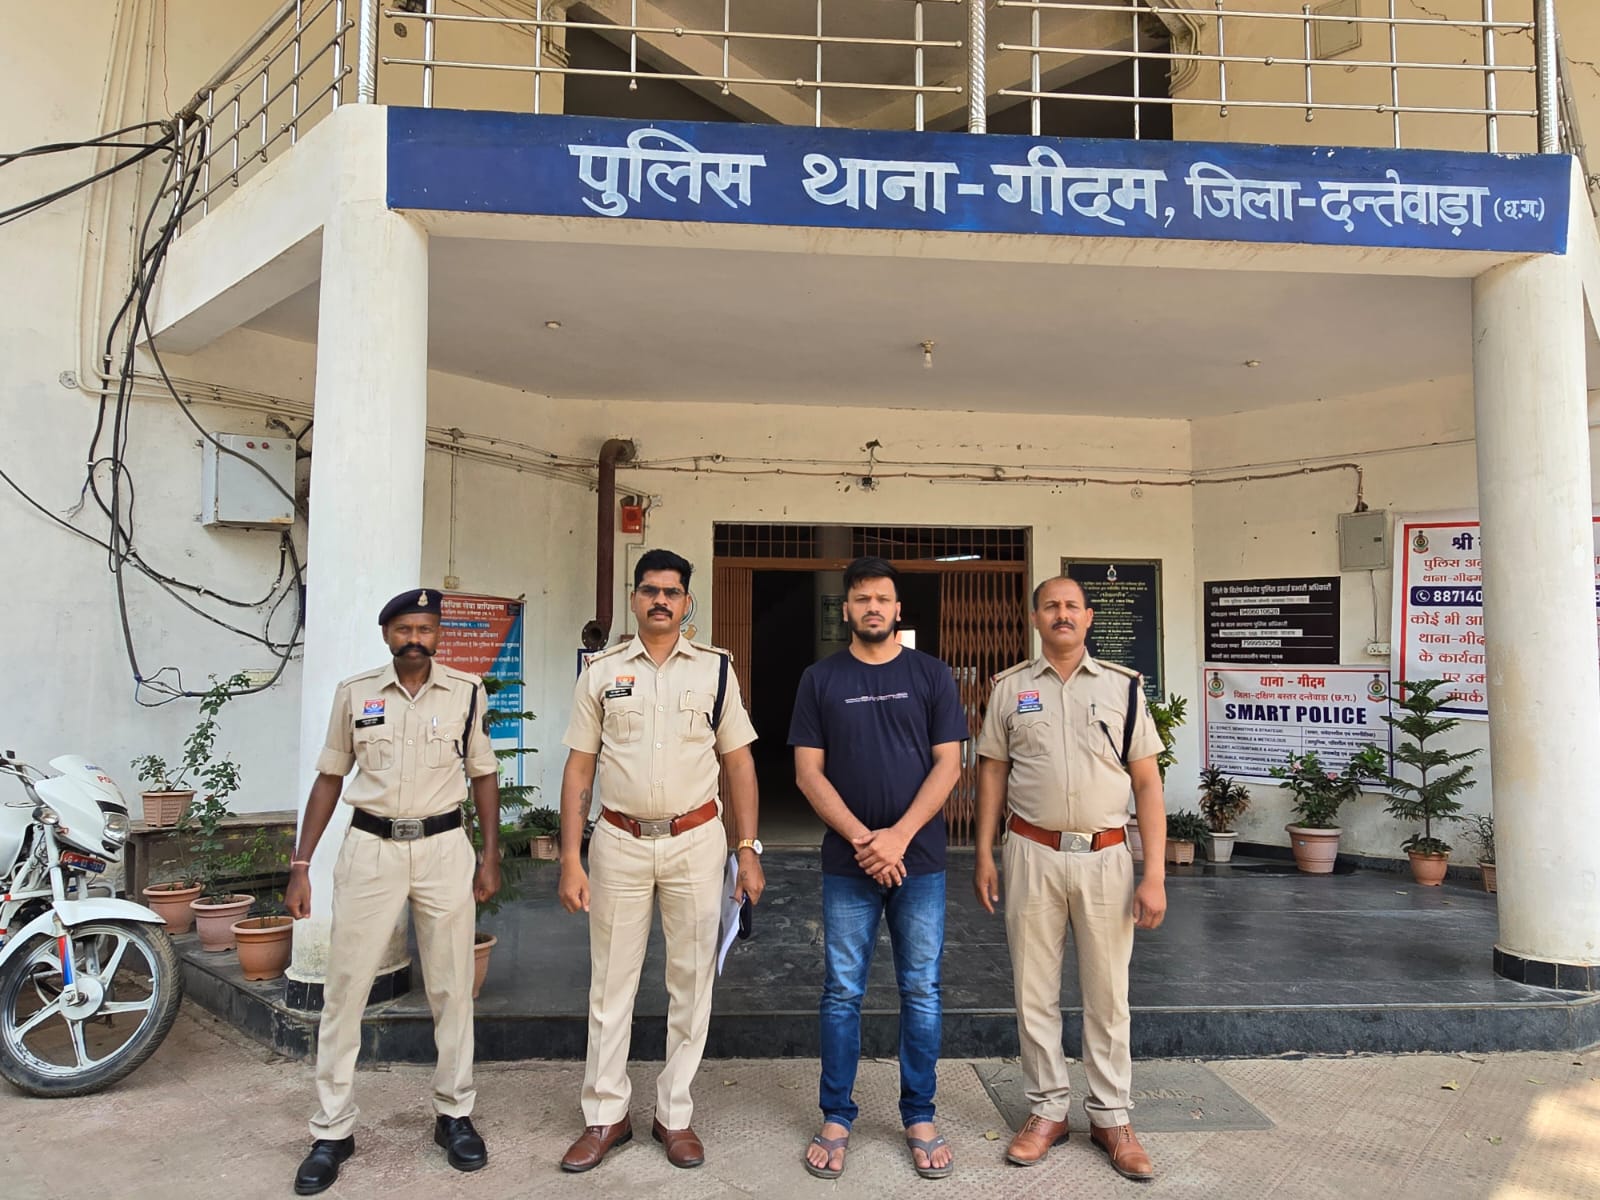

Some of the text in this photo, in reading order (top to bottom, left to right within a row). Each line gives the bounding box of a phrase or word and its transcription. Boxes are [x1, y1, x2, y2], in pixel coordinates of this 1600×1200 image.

[568, 128, 766, 216] पुलिस
[1452, 533, 1473, 550] श्री
[1424, 557, 1460, 571] पुलिस
[1433, 590, 1482, 602] 887140
[1411, 611, 1440, 626] कोई
[1445, 611, 1461, 625] भी
[1419, 631, 1486, 645] थाना-गीद
[1419, 649, 1485, 664] के कार्यवा
[1297, 674, 1326, 688] गीदम
[1225, 703, 1367, 725] SMART POLICE
